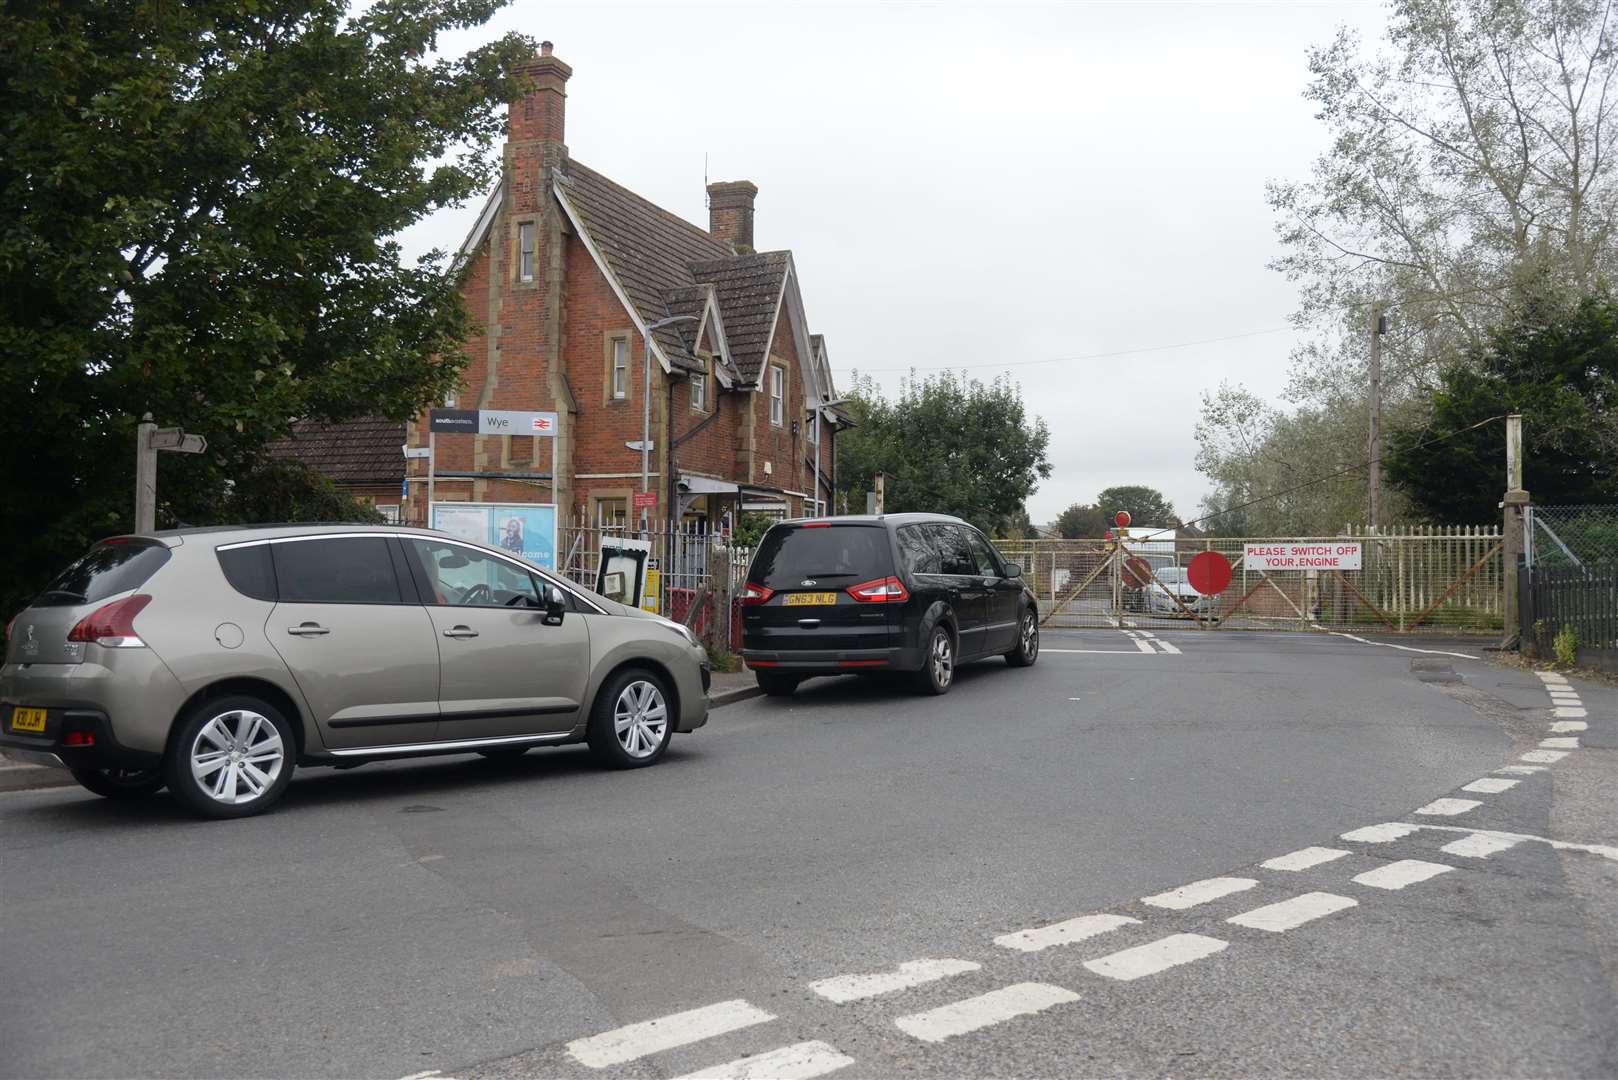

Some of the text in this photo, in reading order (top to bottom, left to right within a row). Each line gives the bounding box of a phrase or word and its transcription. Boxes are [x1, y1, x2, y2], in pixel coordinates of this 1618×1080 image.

[487, 417, 509, 428] Wye
[1247, 546, 1357, 556] PLEASE SWITCH OFF
[1265, 557, 1339, 567] YOUR ENGINE
